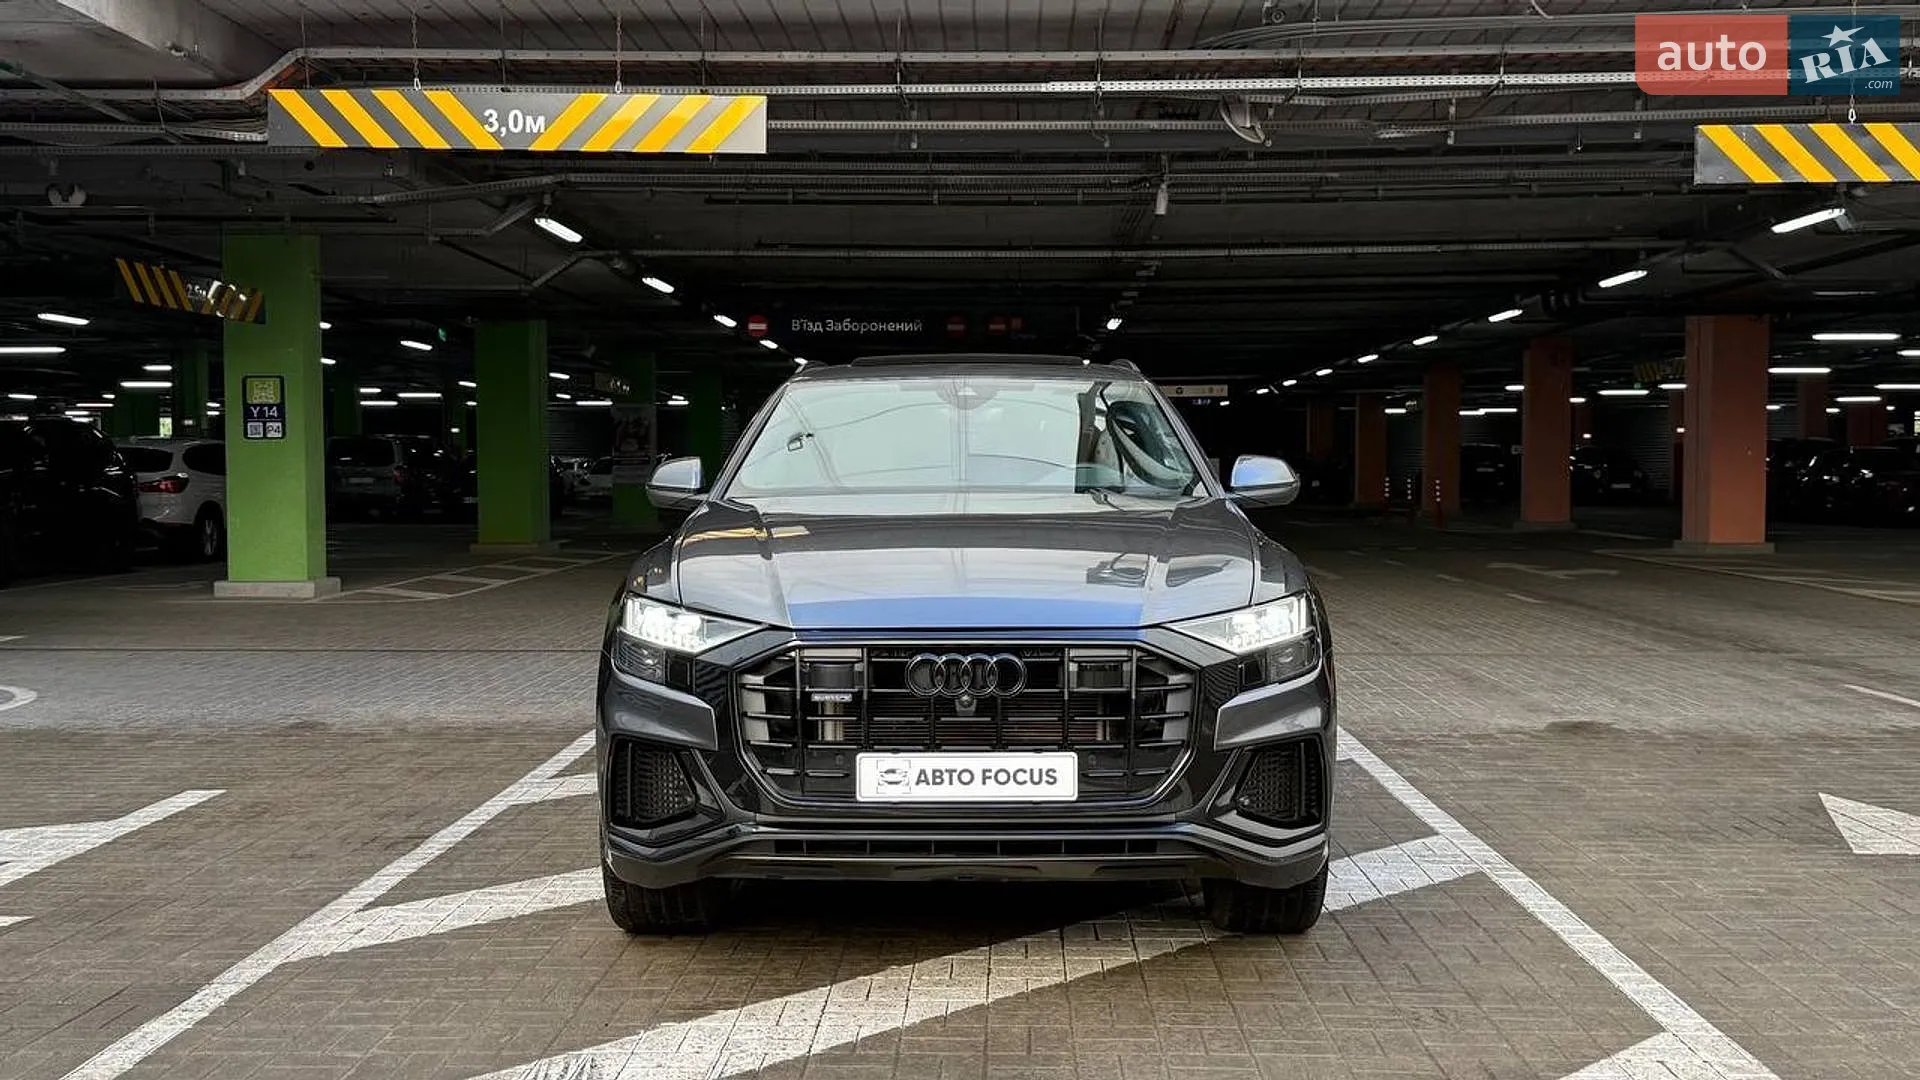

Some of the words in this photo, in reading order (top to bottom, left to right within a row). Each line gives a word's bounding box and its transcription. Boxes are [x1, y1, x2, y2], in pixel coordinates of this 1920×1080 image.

[483, 108, 546, 138] 3,0м
[825, 317, 922, 334] Заборонений
[262, 405, 278, 418] 14
[915, 768, 975, 786] АВТО
[981, 768, 1058, 786] FOCUS
